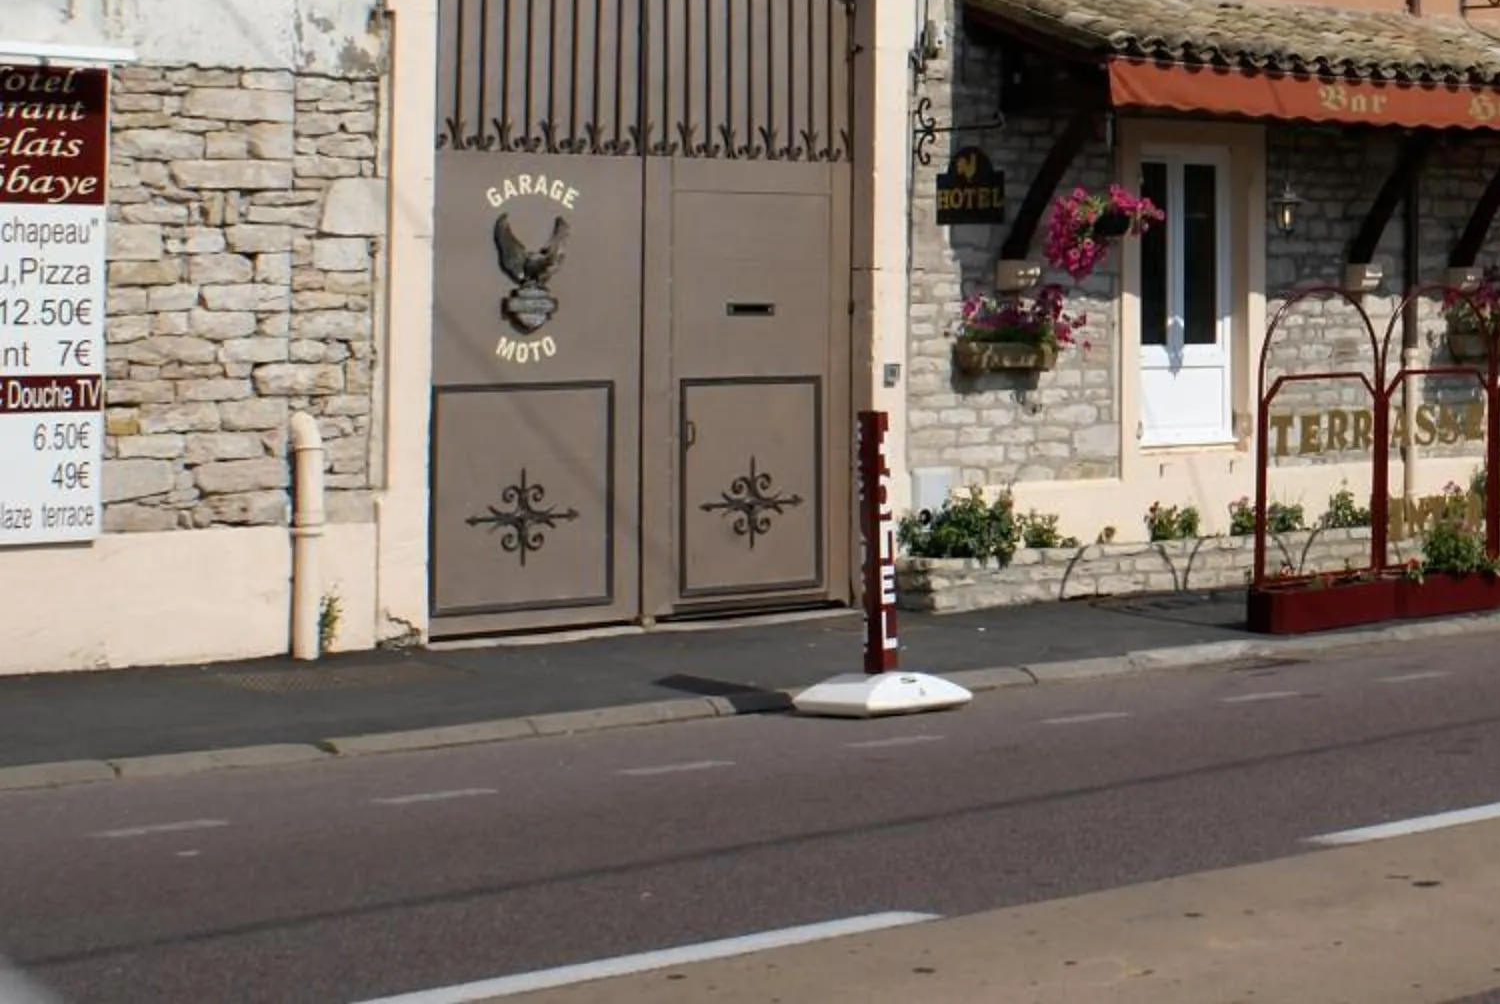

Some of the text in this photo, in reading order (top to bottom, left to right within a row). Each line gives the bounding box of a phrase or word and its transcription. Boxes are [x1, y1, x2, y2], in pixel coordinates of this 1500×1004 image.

[0, 65, 85, 94] otel
[0, 100, 86, 122] rant
[1317, 82, 1389, 116] Bar
[0, 163, 98, 203] baye
[485, 173, 581, 210] GARAGE
[937, 187, 1004, 210] HOTEL
[58, 339, 93, 367] 7€
[495, 335, 557, 364] MOTO
[7, 379, 73, 410] Douche
[76, 379, 101, 408] TV
[33, 421, 91, 452] 6.50€
[51, 461, 91, 490] 49€
[41, 501, 94, 528] terrace
